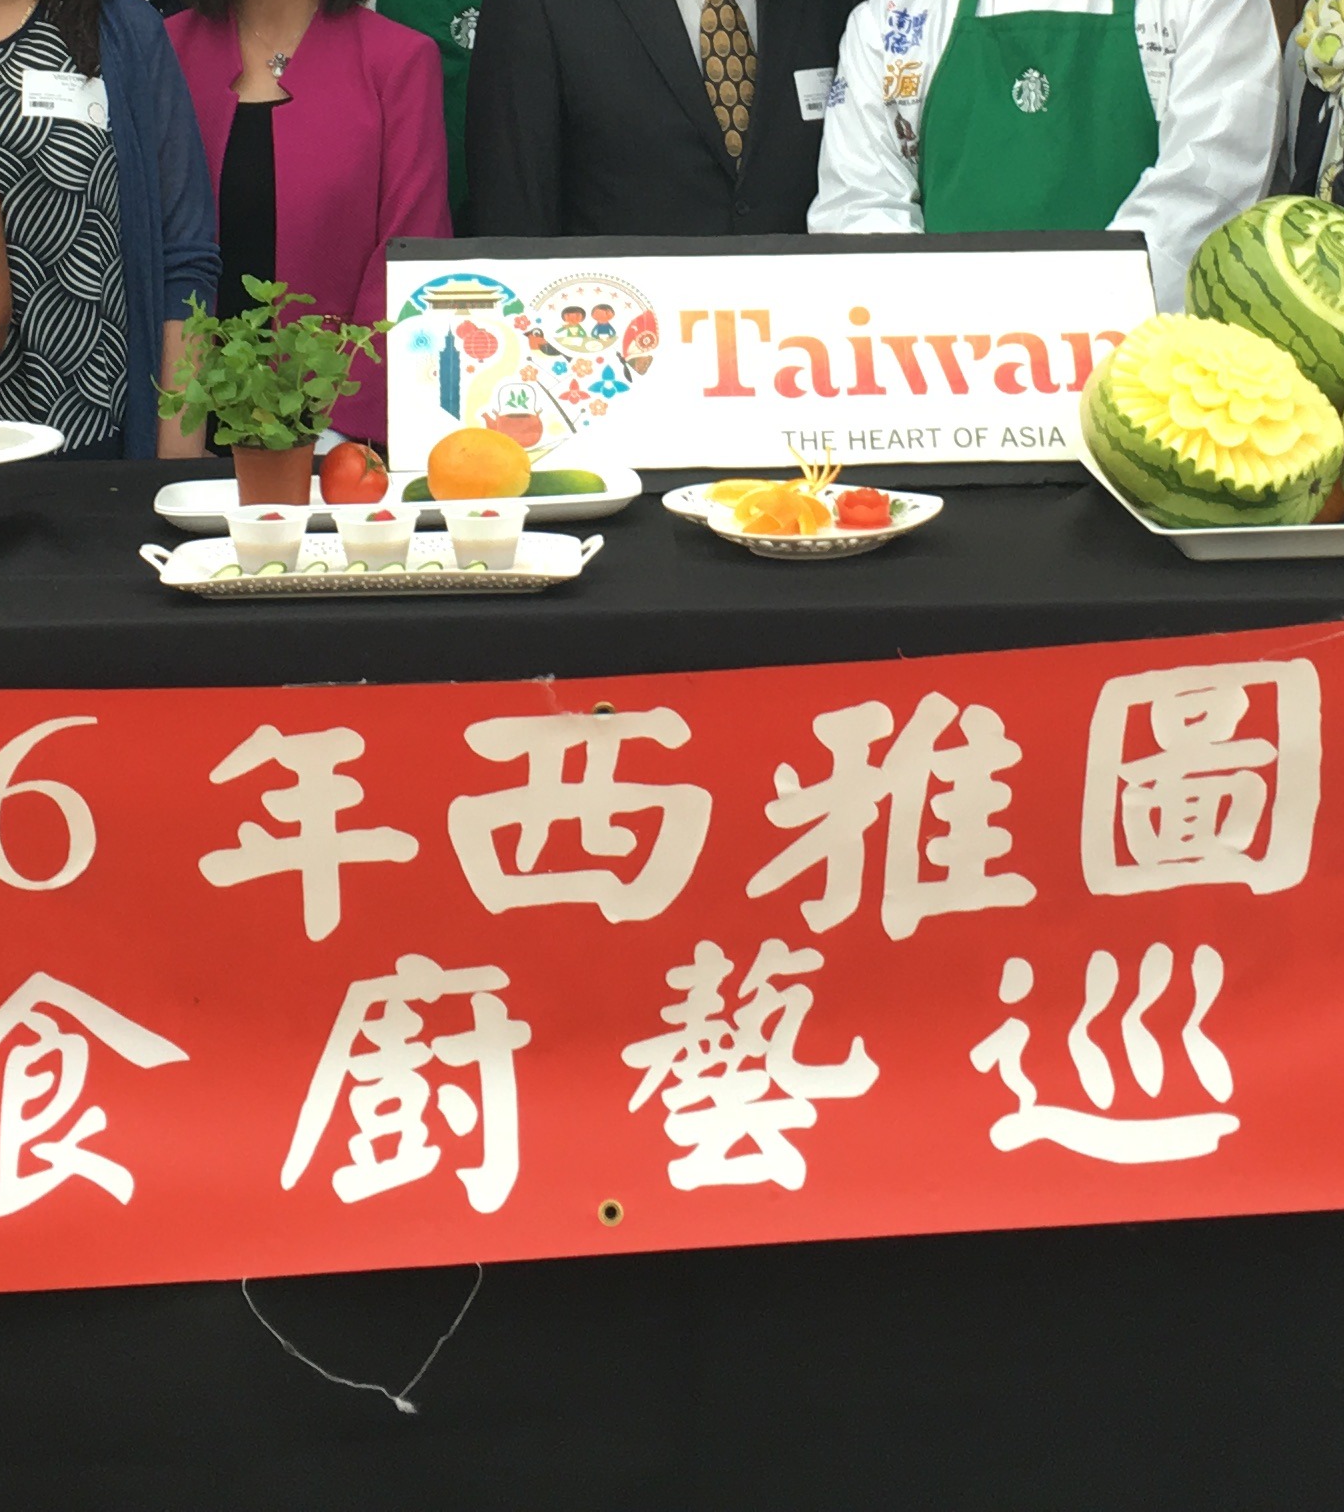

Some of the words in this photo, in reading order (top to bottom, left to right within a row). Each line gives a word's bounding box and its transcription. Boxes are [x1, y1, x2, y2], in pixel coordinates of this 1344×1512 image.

[782, 430, 837, 452] THE
[848, 428, 942, 451] HEART
[953, 427, 989, 449] OF
[1000, 426, 1067, 448] ASIA
